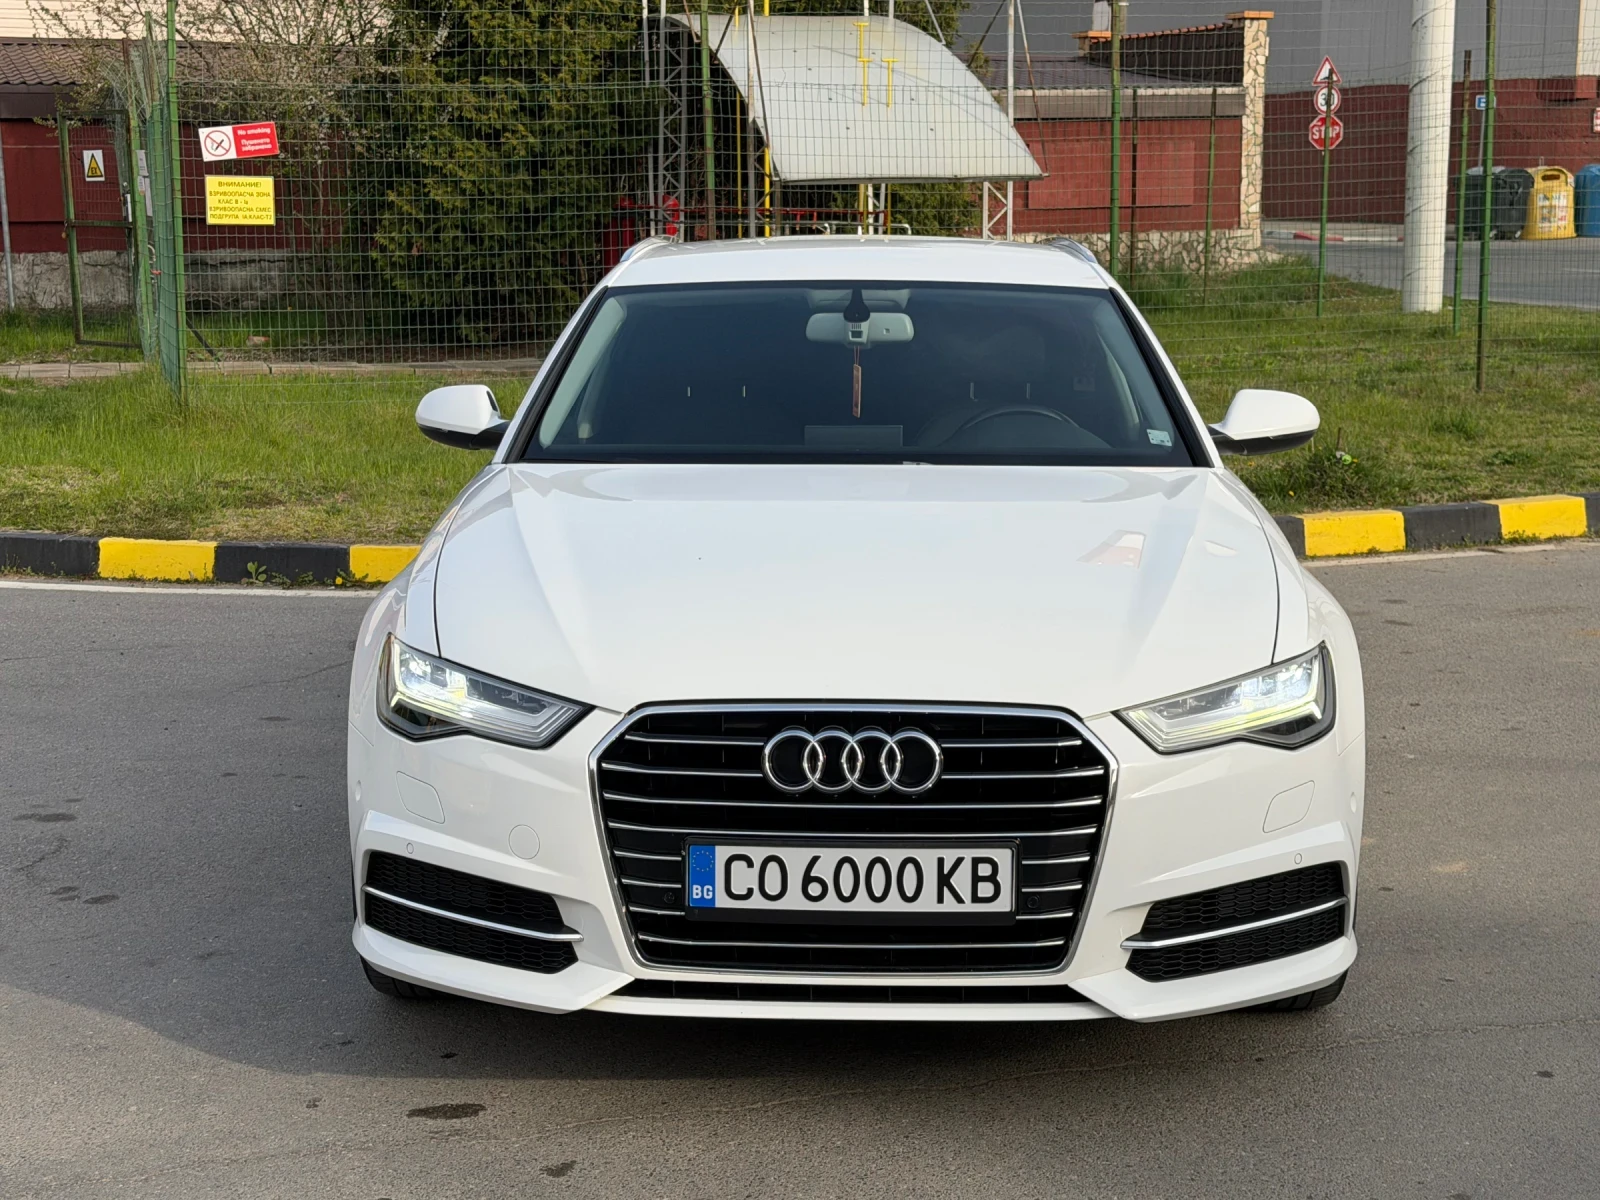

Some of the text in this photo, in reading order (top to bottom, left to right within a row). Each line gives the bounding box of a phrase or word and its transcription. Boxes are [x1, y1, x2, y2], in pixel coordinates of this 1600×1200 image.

[247, 127, 271, 135] smoking
[723, 852, 1002, 905] CO 6000 KB
[692, 885, 713, 899] BG
